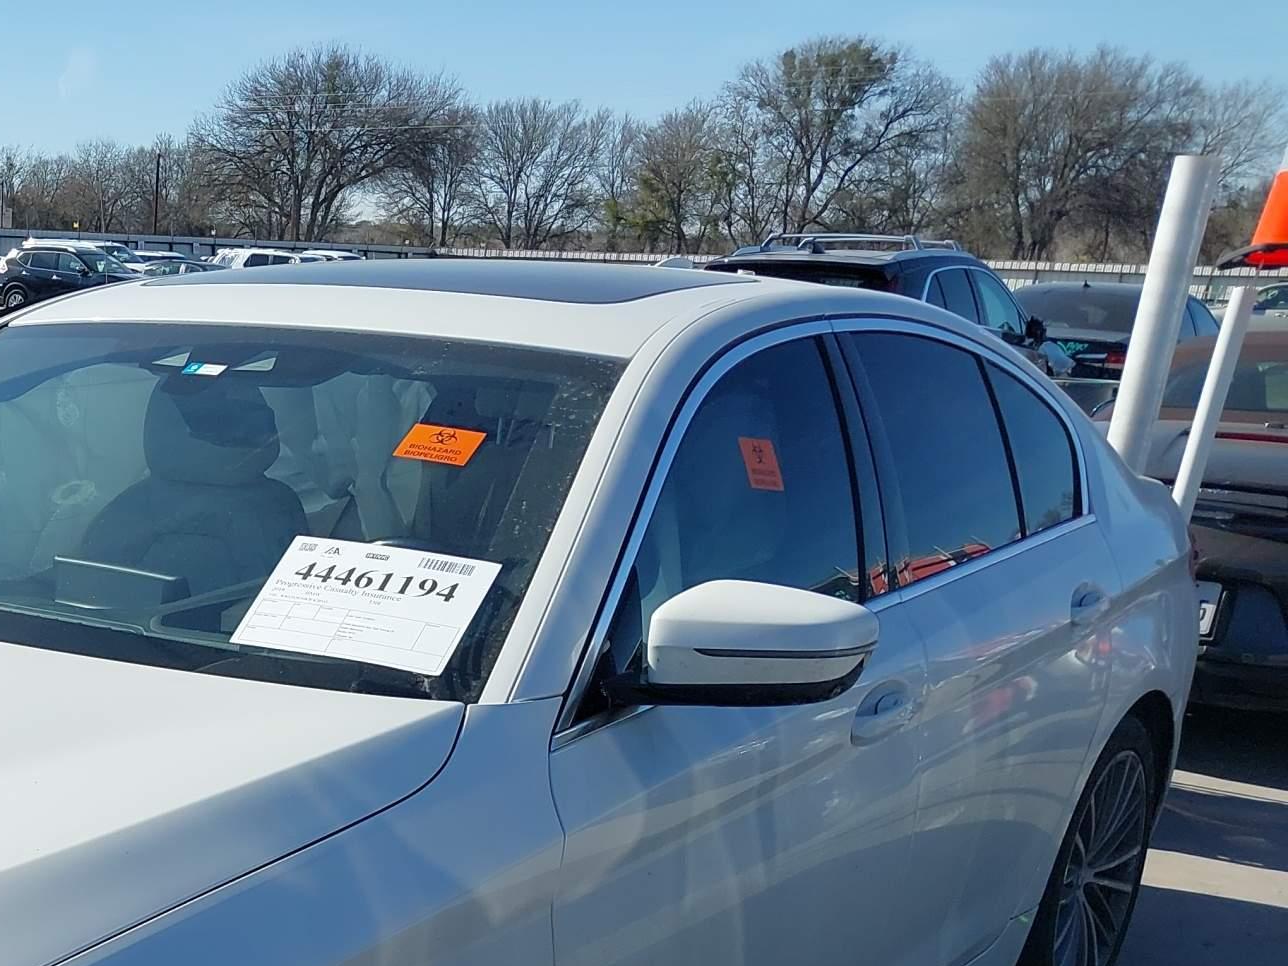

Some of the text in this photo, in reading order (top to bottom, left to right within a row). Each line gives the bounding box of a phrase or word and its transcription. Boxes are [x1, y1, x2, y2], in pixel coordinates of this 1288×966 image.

[403, 449, 458, 462] BIOPELIGRO
[408, 443, 462, 455] BIOHAZARD
[275, 579, 322, 591] Progressive
[324, 583, 359, 596] Casualty
[361, 589, 402, 602] Insurance
[294, 561, 461, 603] 44461194
